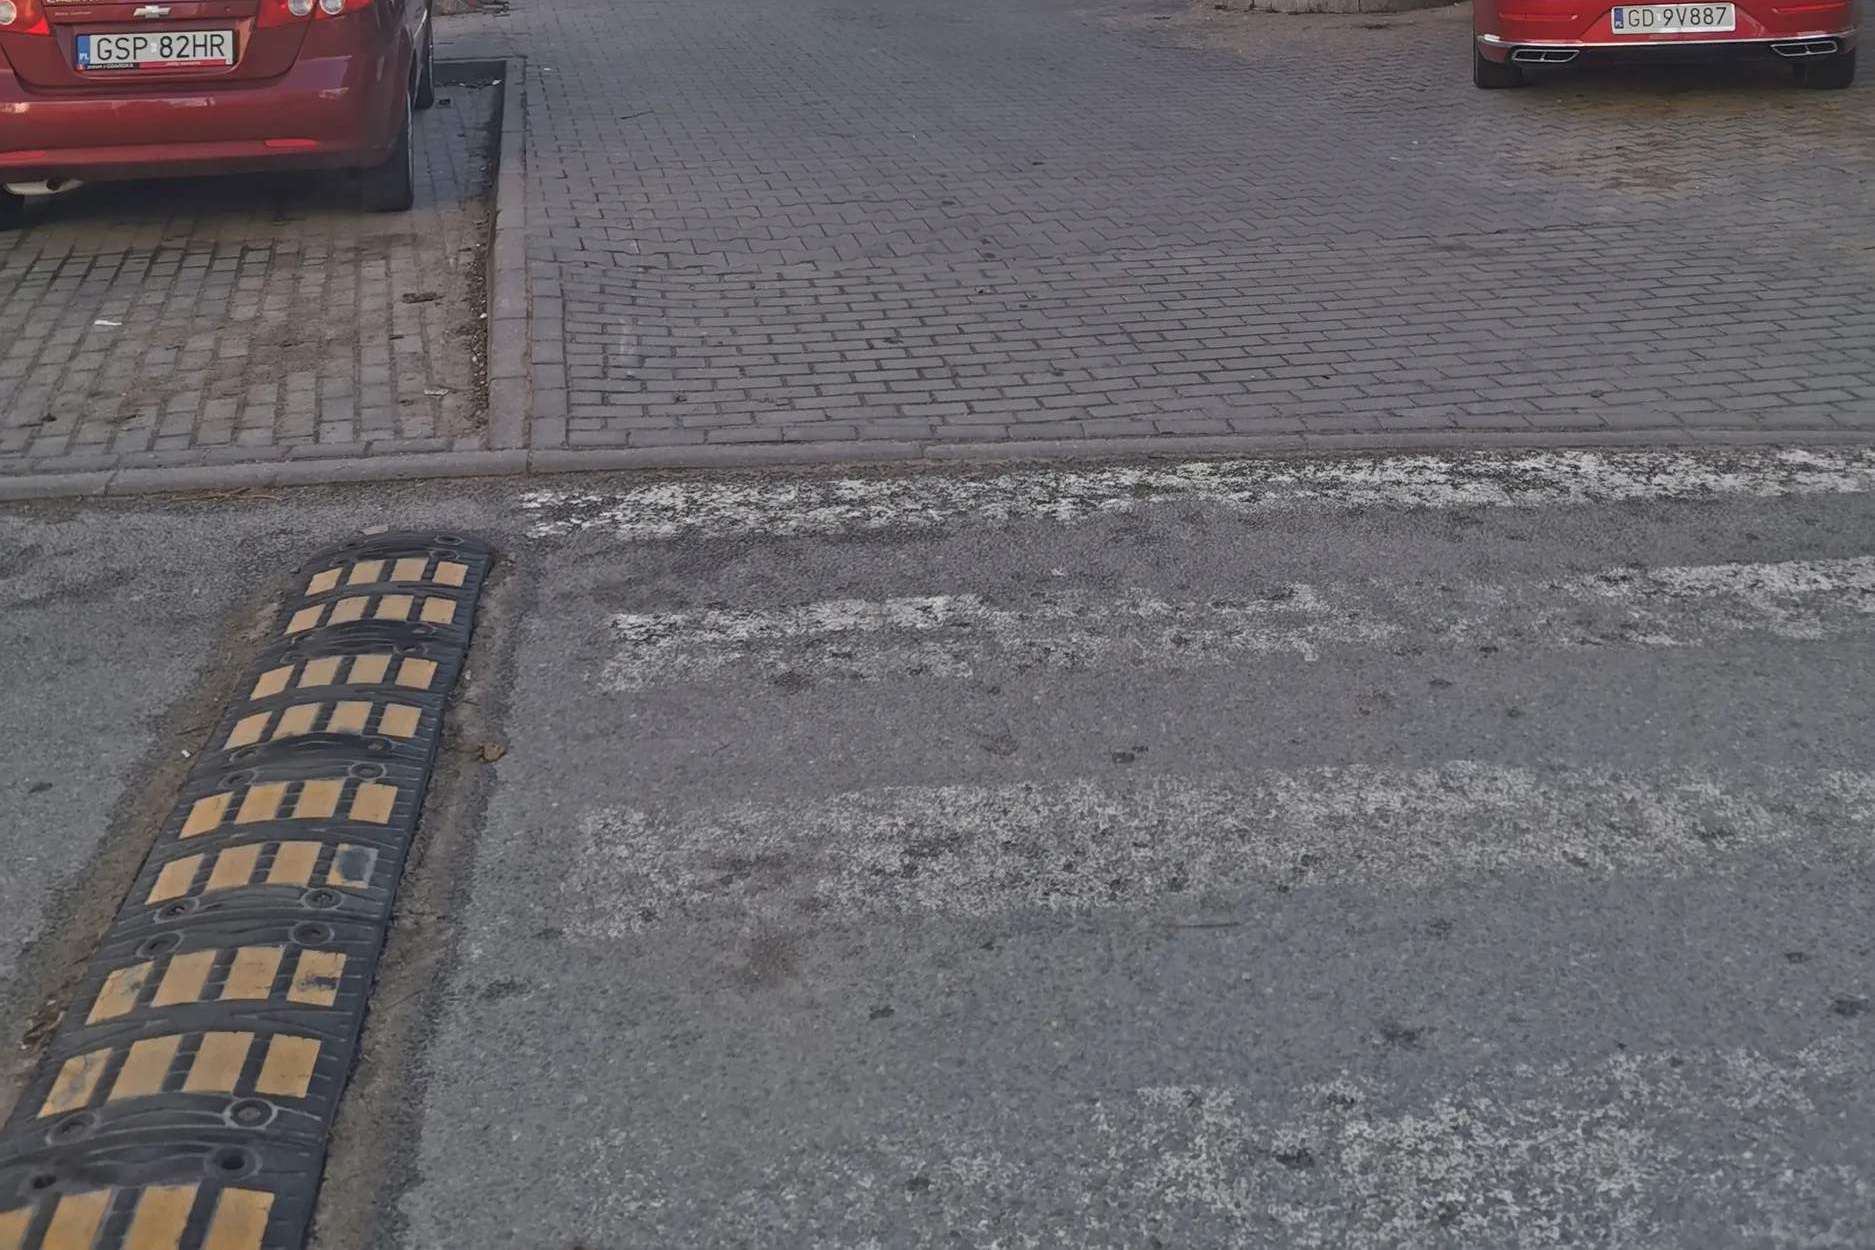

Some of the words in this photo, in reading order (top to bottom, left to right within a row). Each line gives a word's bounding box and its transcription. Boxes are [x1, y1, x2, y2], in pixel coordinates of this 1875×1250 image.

[1628, 8, 1654, 28] GD
[1663, 6, 1727, 27] 9V887
[96, 37, 148, 61] GSP
[159, 34, 226, 58] 82HR
